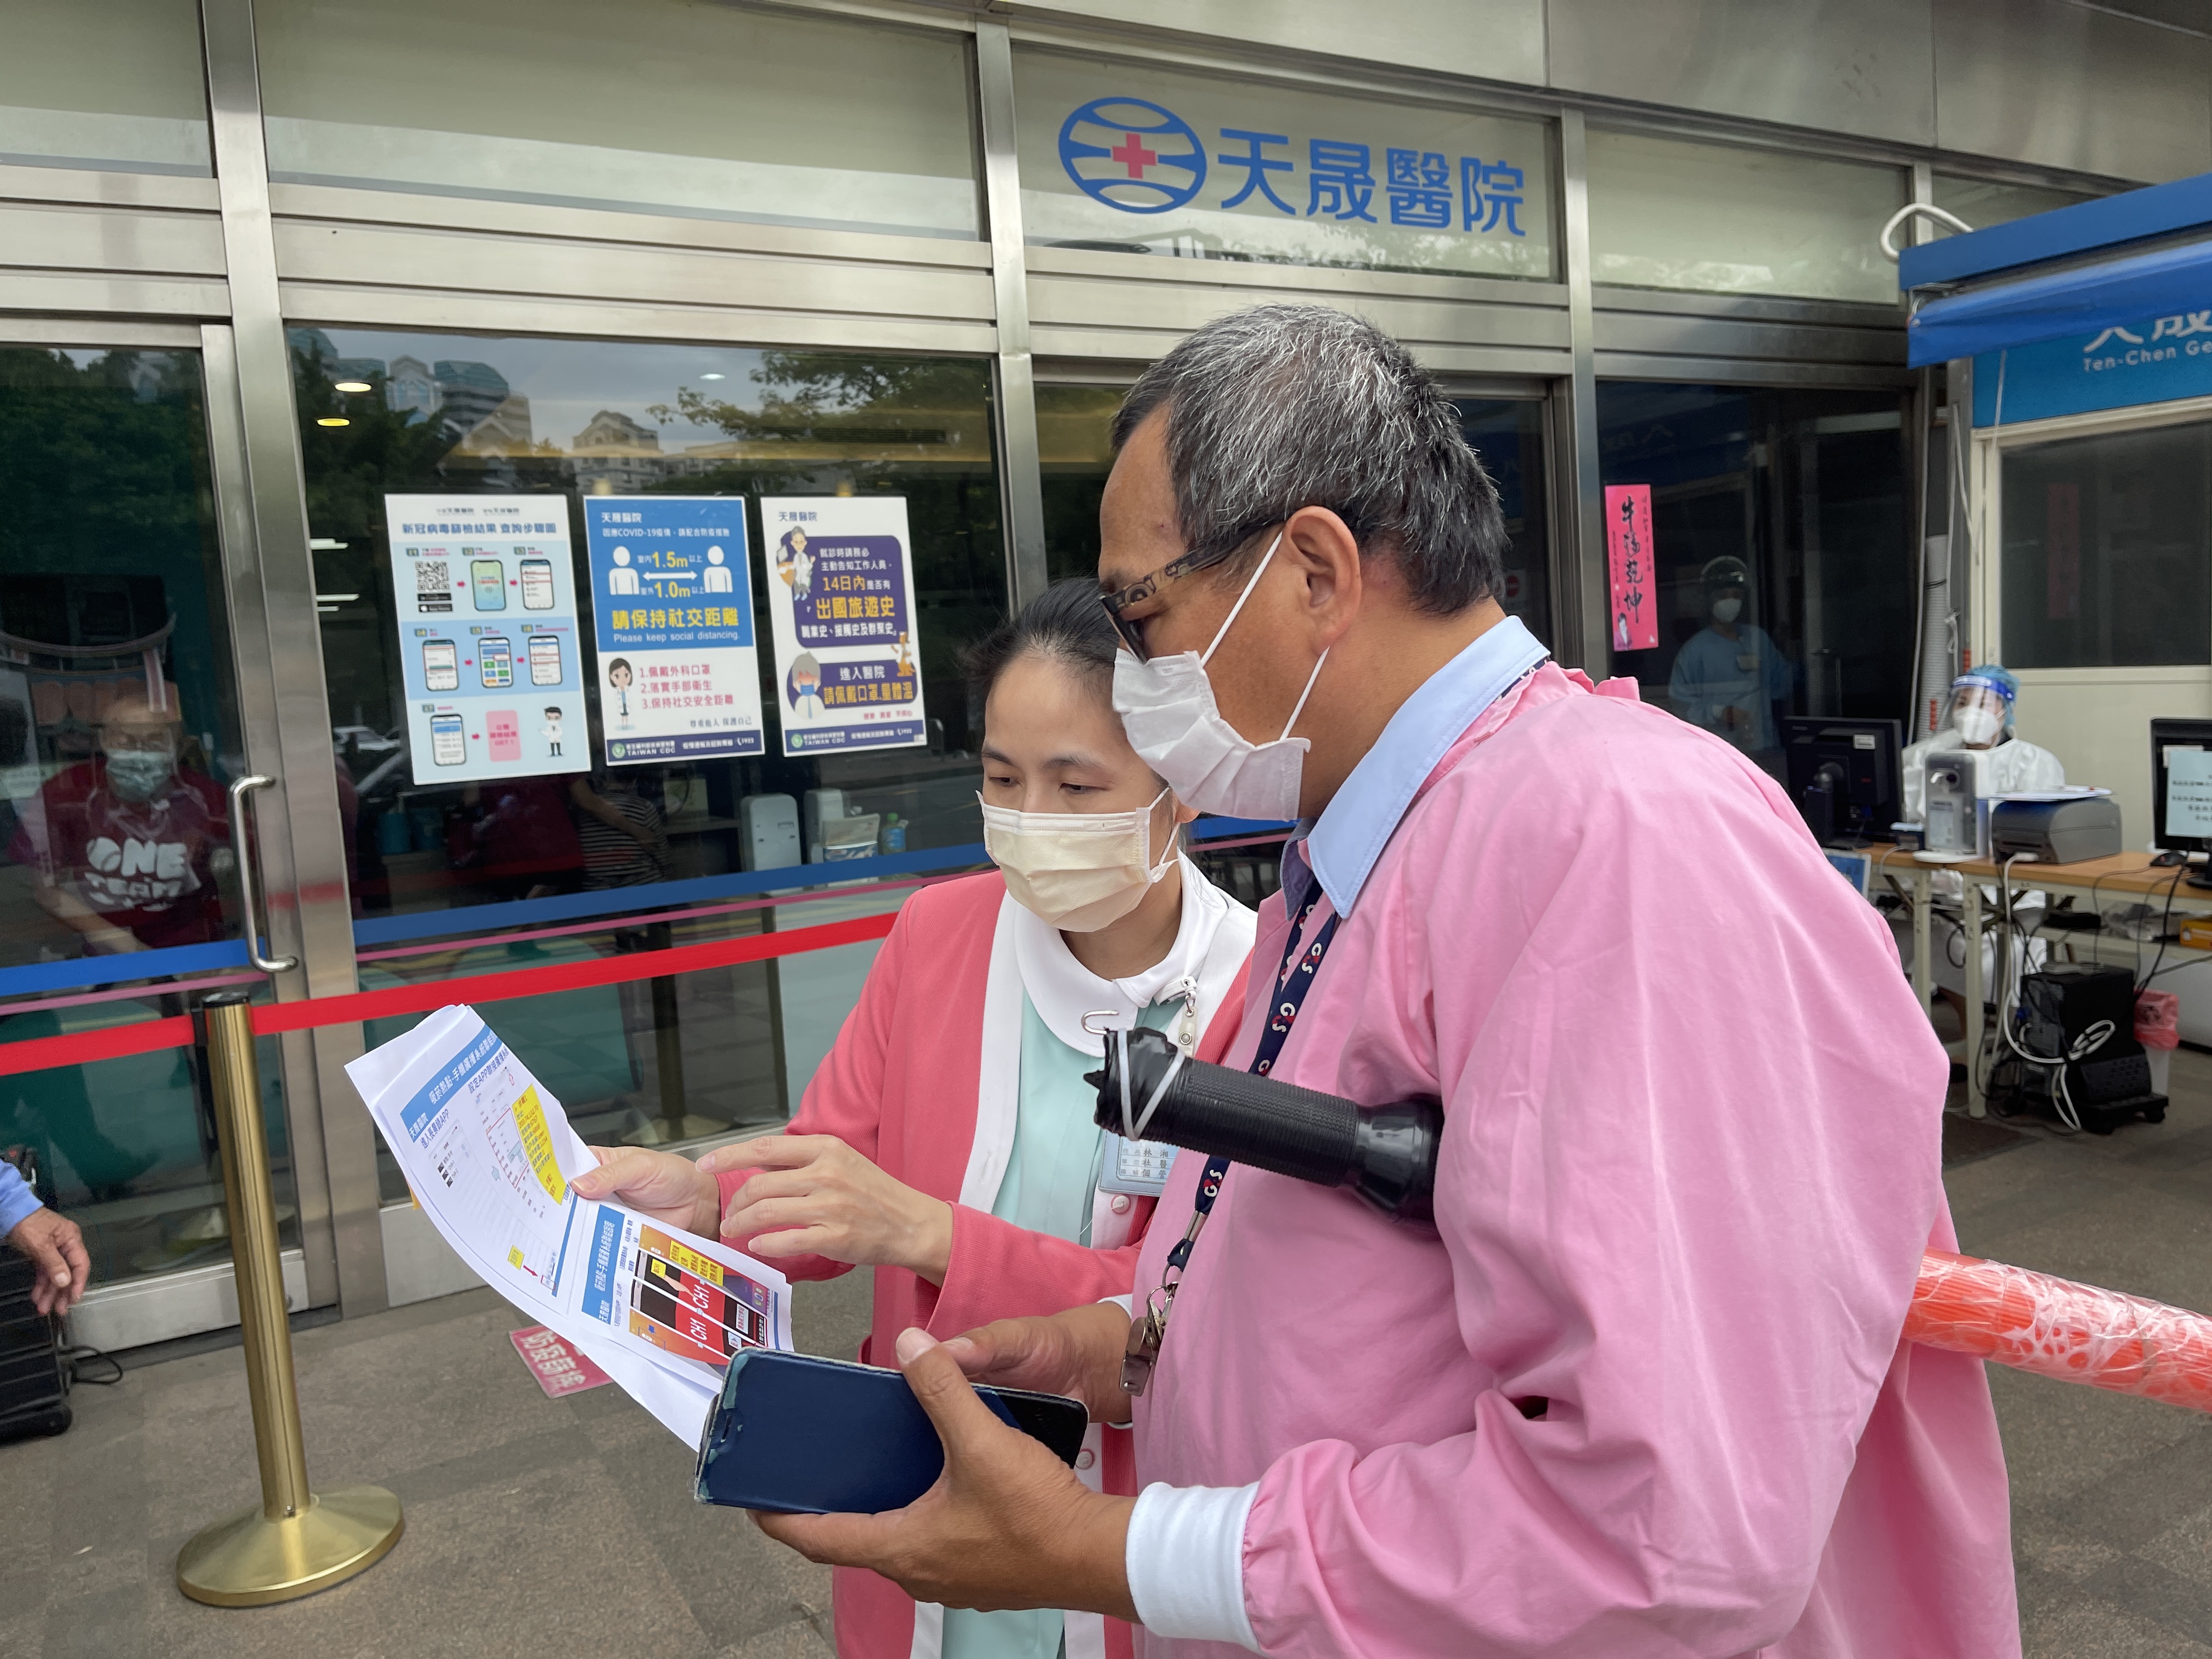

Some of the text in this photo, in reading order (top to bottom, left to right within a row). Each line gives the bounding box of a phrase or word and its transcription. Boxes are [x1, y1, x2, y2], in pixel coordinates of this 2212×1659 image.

[1217, 127, 1527, 236] 天晟醫院
[2083, 347, 2177, 372] Ten-Chen
[601, 512, 642, 523] 天晟醫院
[778, 511, 817, 522] 天晟醫院
[402, 523, 497, 535] 新冠病毒篩檢結果
[612, 606, 739, 630] 請保持社交距離
[613, 633, 643, 643] Please
[646, 633, 667, 644] keep
[670, 631, 694, 641] social
[839, 665, 885, 681] 進入醫院
[642, 694, 734, 710] 3.保持社交安全距離
[627, 747, 676, 757] TAIWAN CDC
[86, 836, 187, 881] ONE
[692, 1284, 710, 1309] CH1
[690, 1317, 708, 1341] CH1
